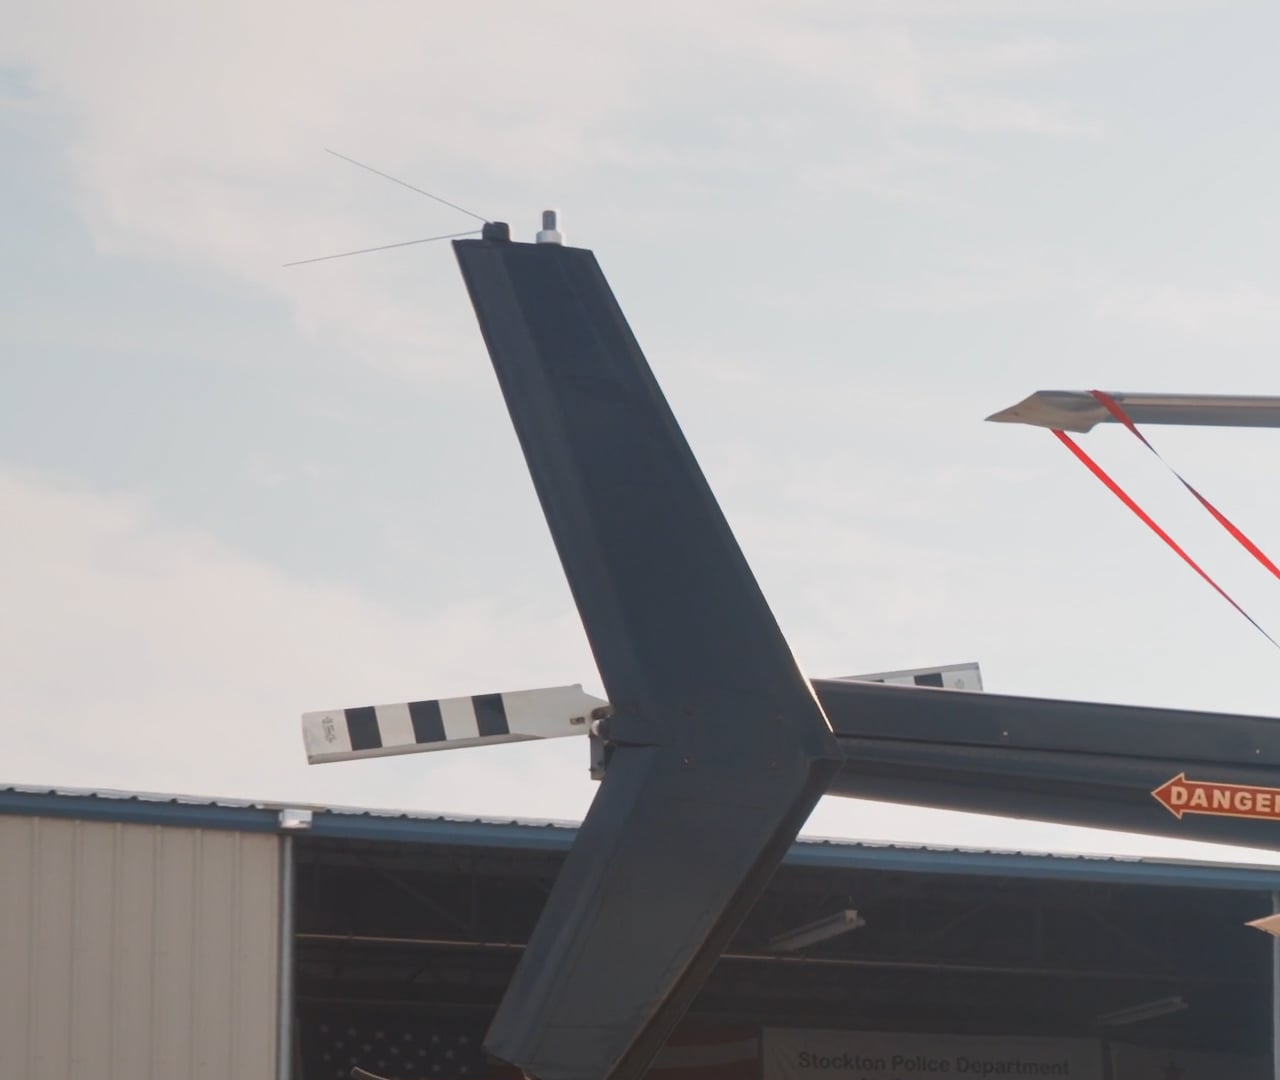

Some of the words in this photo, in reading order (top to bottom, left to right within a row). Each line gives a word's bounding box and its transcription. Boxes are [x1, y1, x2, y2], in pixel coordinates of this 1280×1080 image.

[799, 1051, 886, 1072] Stockton
[892, 1055, 949, 1073] Police
[956, 1057, 1070, 1077] Department
